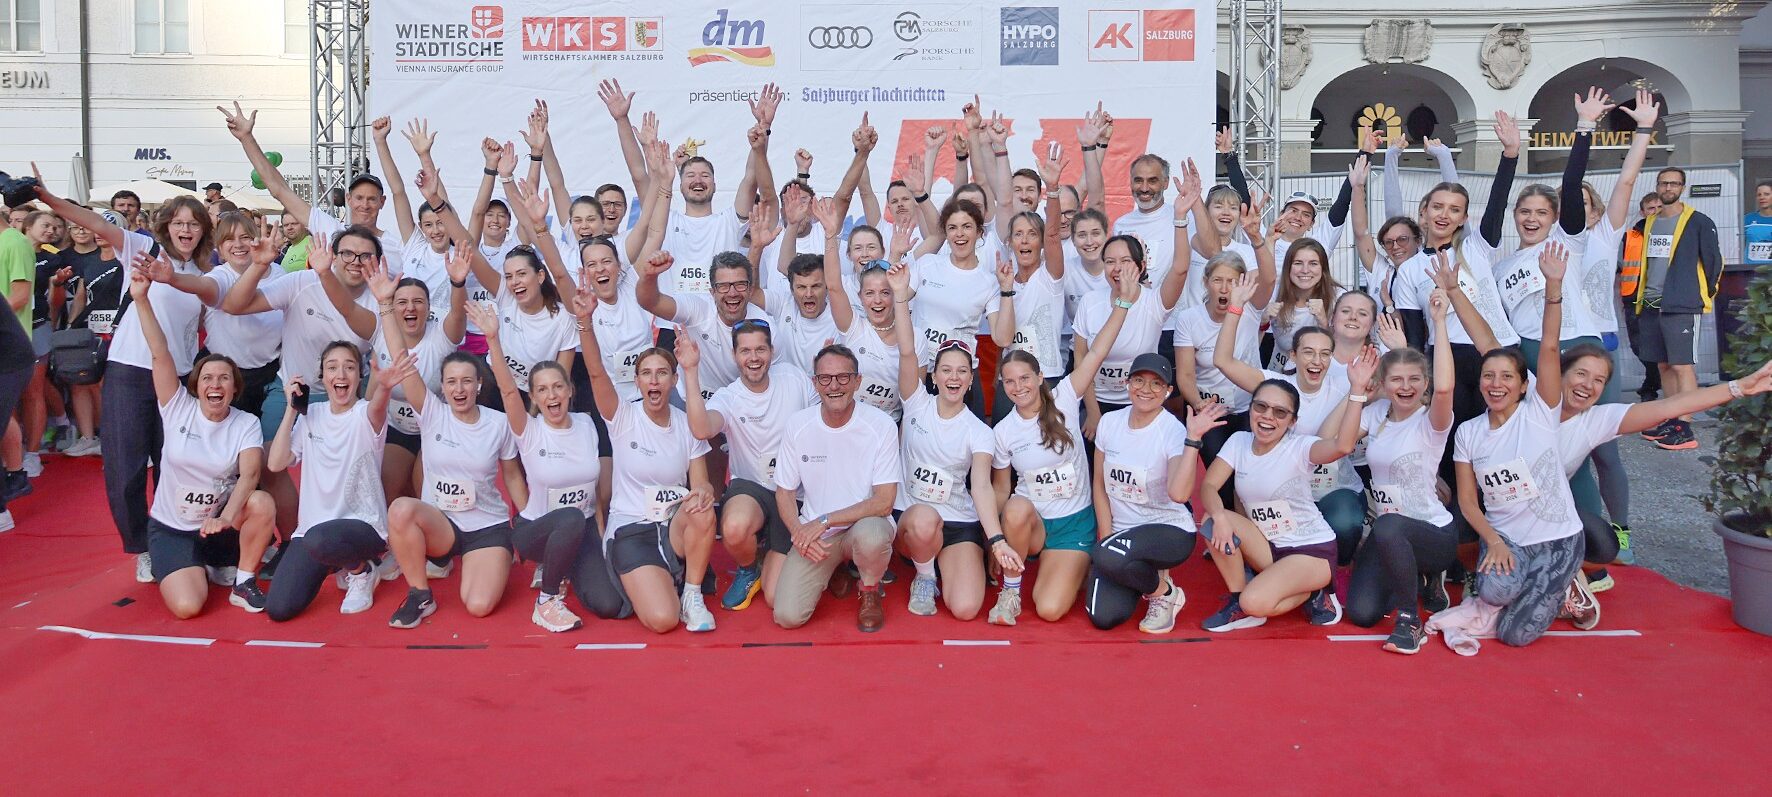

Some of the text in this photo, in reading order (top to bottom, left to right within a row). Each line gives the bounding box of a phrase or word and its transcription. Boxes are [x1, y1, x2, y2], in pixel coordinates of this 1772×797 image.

[396, 23, 469, 39] WIENER
[525, 22, 618, 47] WKS
[702, 9, 766, 46] dm
[1002, 24, 1057, 40] HYPO
[1146, 30, 1194, 41] SALZBURG
[1003, 40, 1057, 48] SALZBURG
[1094, 23, 1134, 49] AK
[395, 41, 504, 57] STÄDTISCHE
[396, 65, 504, 73] VIENNA INSURANCE GROUP
[689, 90, 759, 104] präsentiert
[802, 87, 869, 105] Salzburger
[872, 87, 946, 102] Nachrichten
[1530, 131, 1659, 148] HEIMTWEK
[134, 148, 172, 160] MUS.
[681, 267, 706, 279] 456C
[1505, 268, 1531, 290] 434B
[914, 467, 944, 487] 421B
[1035, 469, 1067, 485] 421C
[1110, 469, 1137, 486] 407A
[1484, 469, 1520, 488] 413B
[436, 481, 466, 496] 402A
[184, 492, 220, 506] 443A
[1251, 507, 1282, 522] 454C
